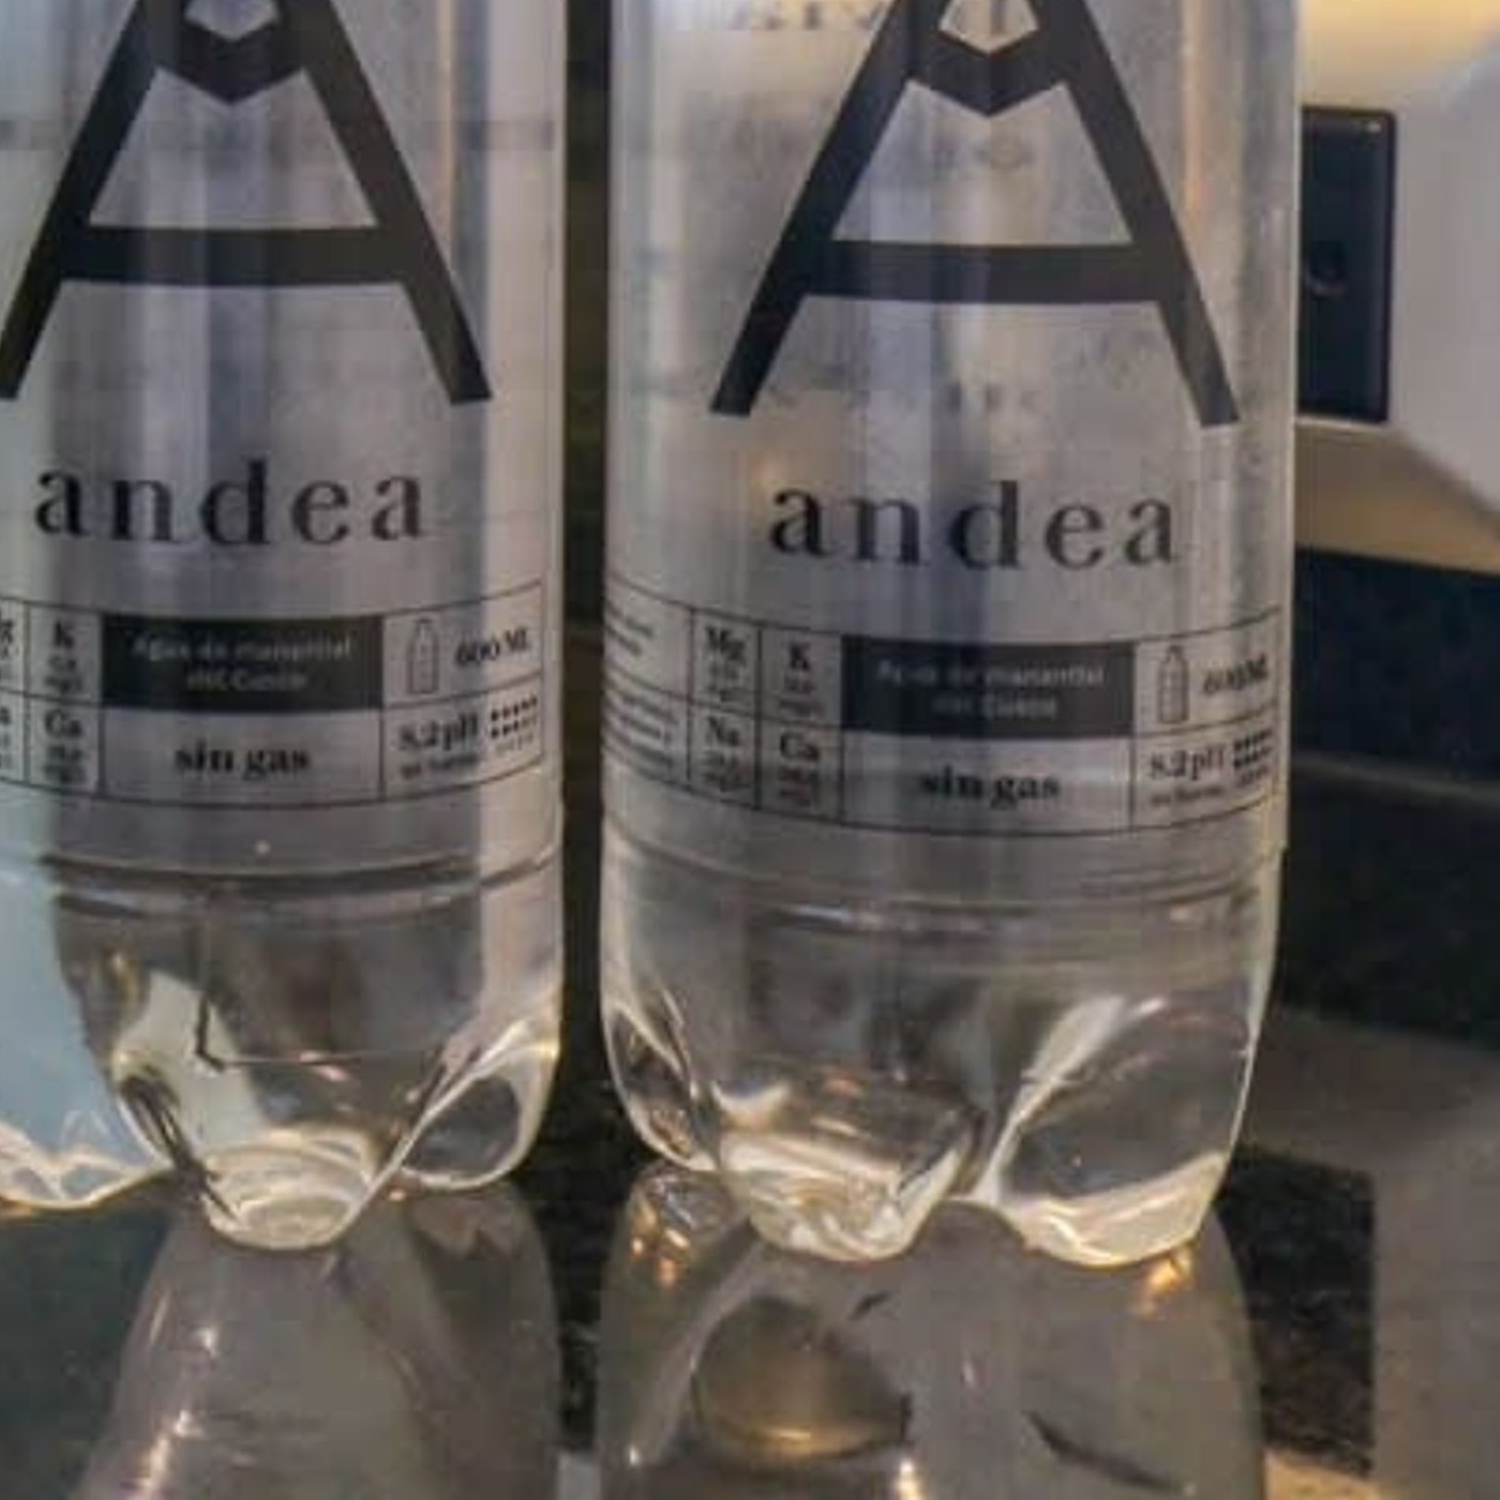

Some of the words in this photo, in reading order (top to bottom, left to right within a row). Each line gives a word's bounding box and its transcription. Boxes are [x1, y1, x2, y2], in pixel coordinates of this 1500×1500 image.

[36, 457, 426, 546] andea
[769, 480, 1175, 569] andea
[175, 740, 234, 772] sin
[243, 748, 311, 782] gas
[919, 763, 984, 799] sin
[991, 776, 1062, 812] gas
